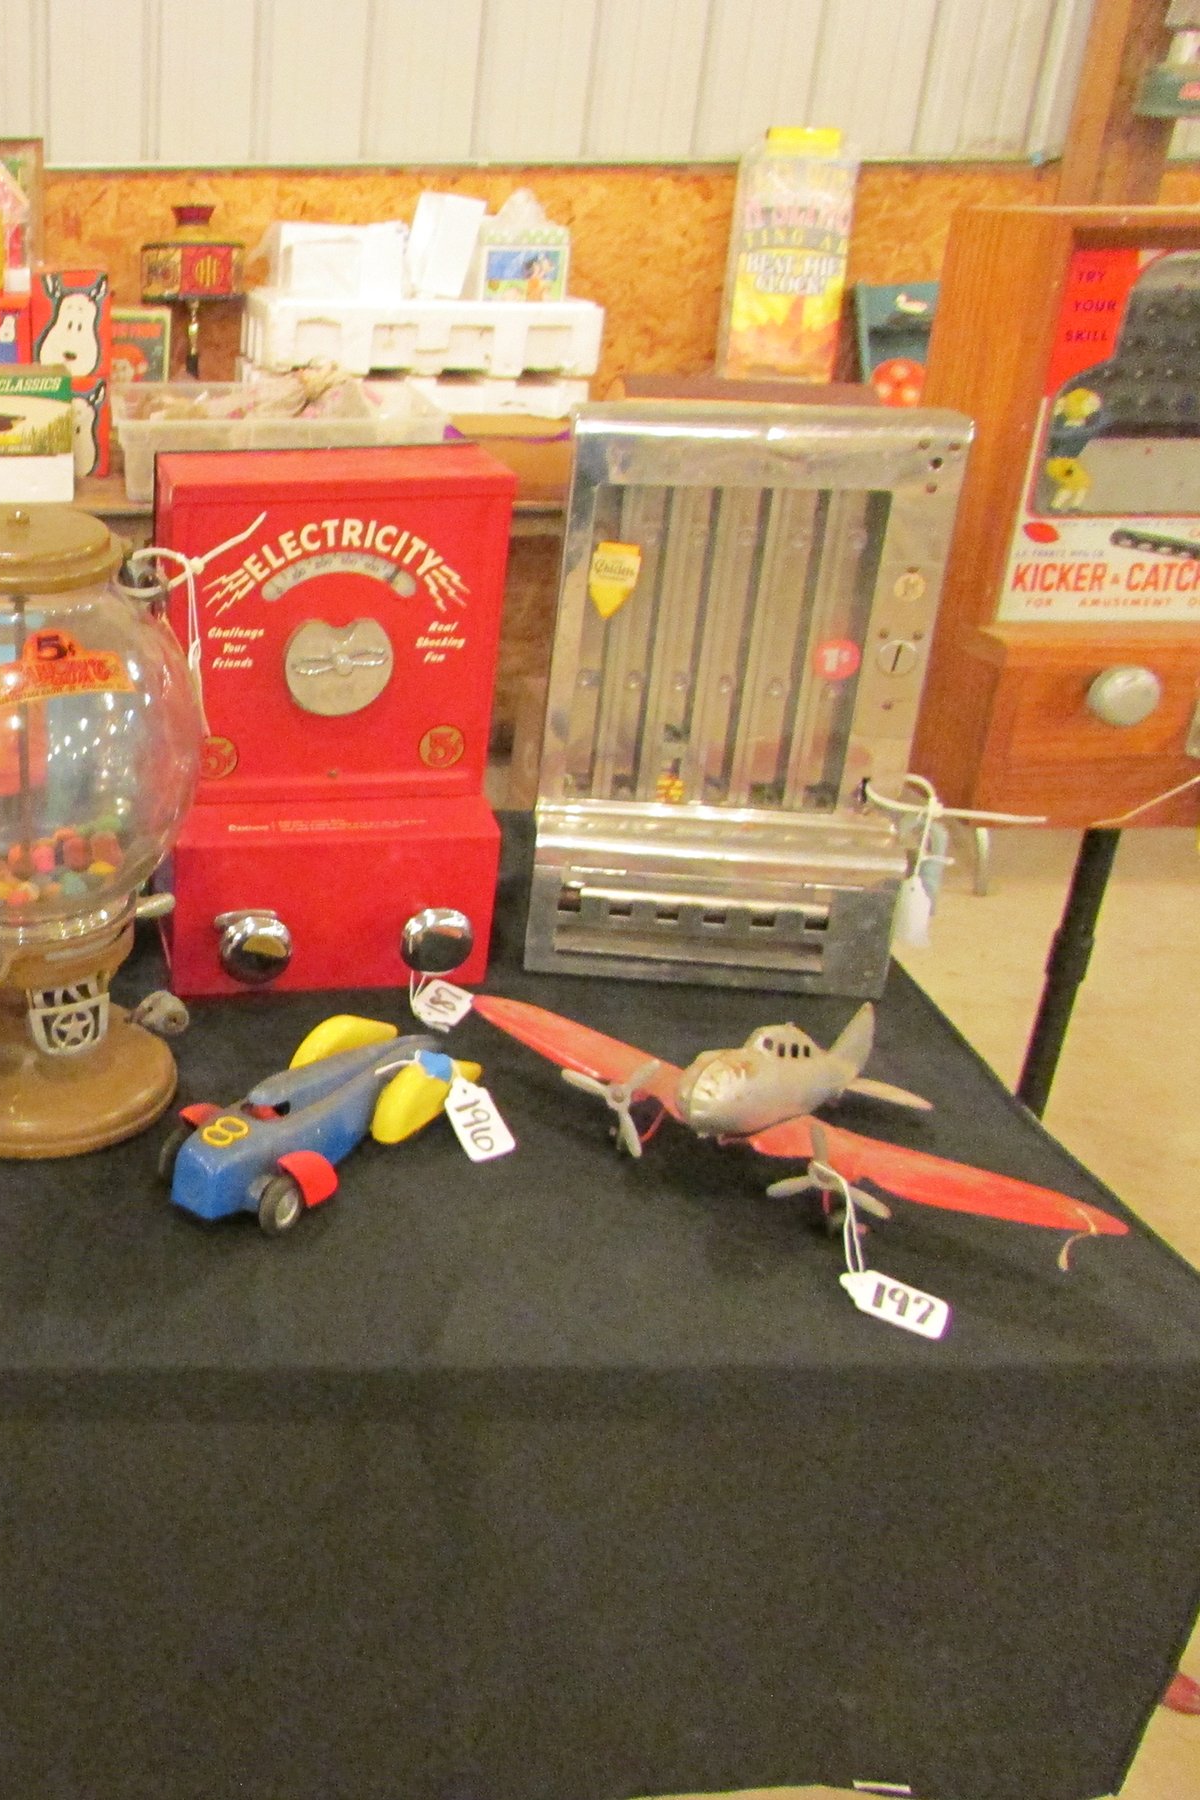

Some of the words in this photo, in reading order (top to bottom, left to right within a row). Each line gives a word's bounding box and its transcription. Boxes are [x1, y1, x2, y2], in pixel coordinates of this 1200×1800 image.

[1074, 300, 1116, 311] YOUR
[1065, 330, 1108, 341] SKILL
[243, 518, 443, 582] ELECTRICITY
[1011, 562, 1107, 592] KICKER
[207, 626, 265, 641] Challenge
[223, 642, 247, 654] Your
[415, 636, 466, 650] Shocking
[212, 657, 253, 669] Friends
[424, 651, 446, 664] Fun
[202, 1115, 249, 1147] 8
[454, 1099, 496, 1152] 196
[872, 1281, 936, 1325] 197
